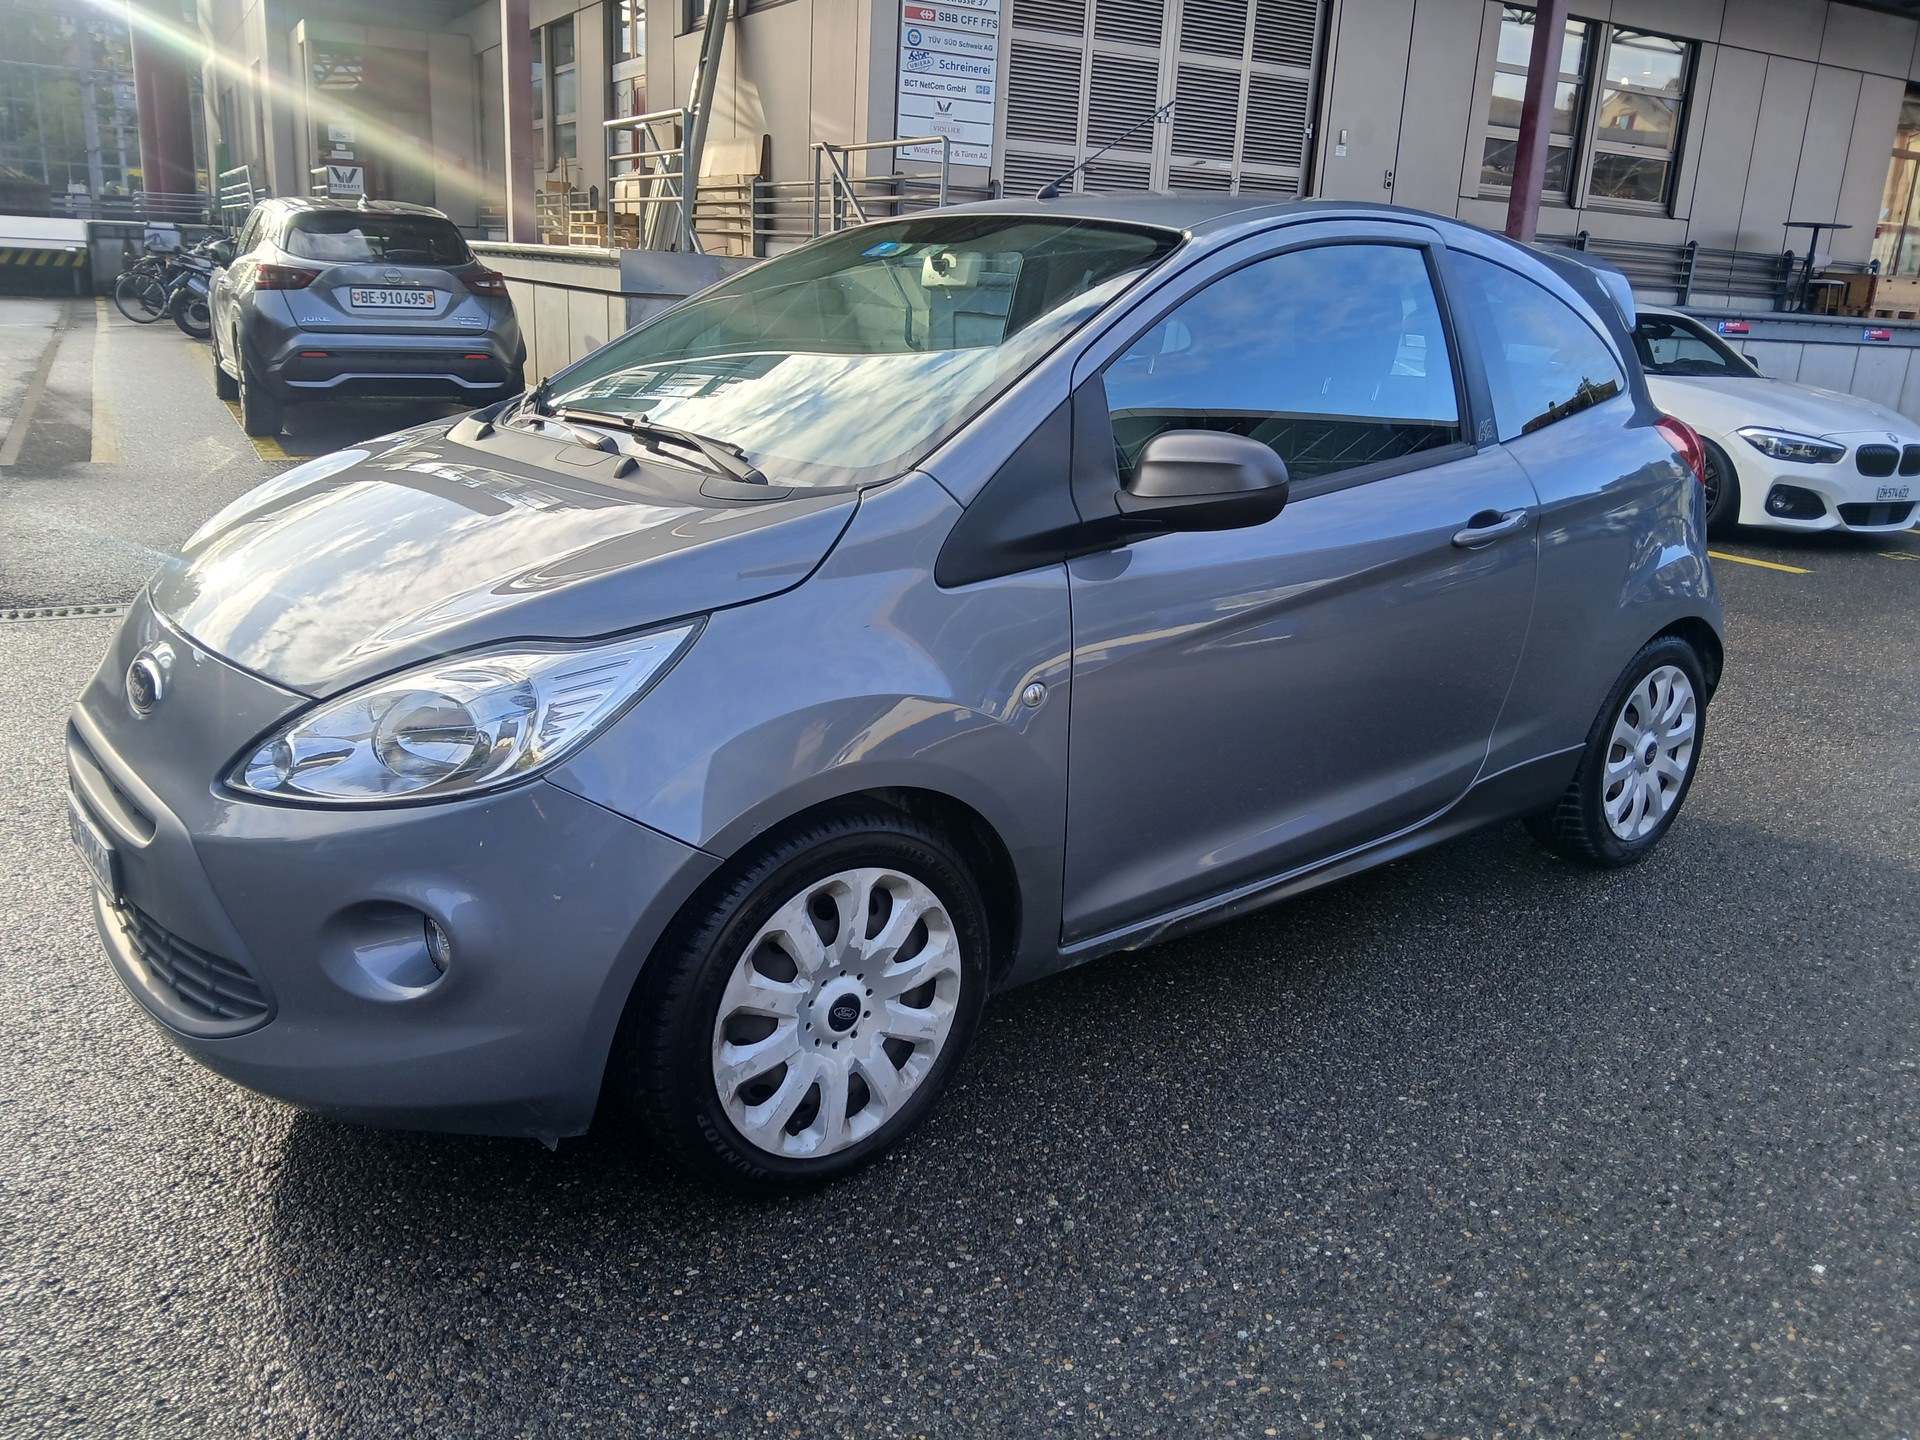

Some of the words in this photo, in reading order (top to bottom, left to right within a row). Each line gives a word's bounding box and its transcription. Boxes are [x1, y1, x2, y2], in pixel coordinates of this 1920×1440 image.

[938, 12, 959, 23] SBB
[960, 15, 979, 26] CFF
[981, 18, 998, 29] FFS
[928, 36, 941, 44] TÜV
[958, 41, 983, 50] Schweiz
[939, 59, 991, 75] Schreinerei
[904, 79, 919, 87] BCT
[919, 81, 945, 91] NetCom
[946, 84, 967, 93] GmbH
[696, 1113, 769, 1181] DUNLOP
